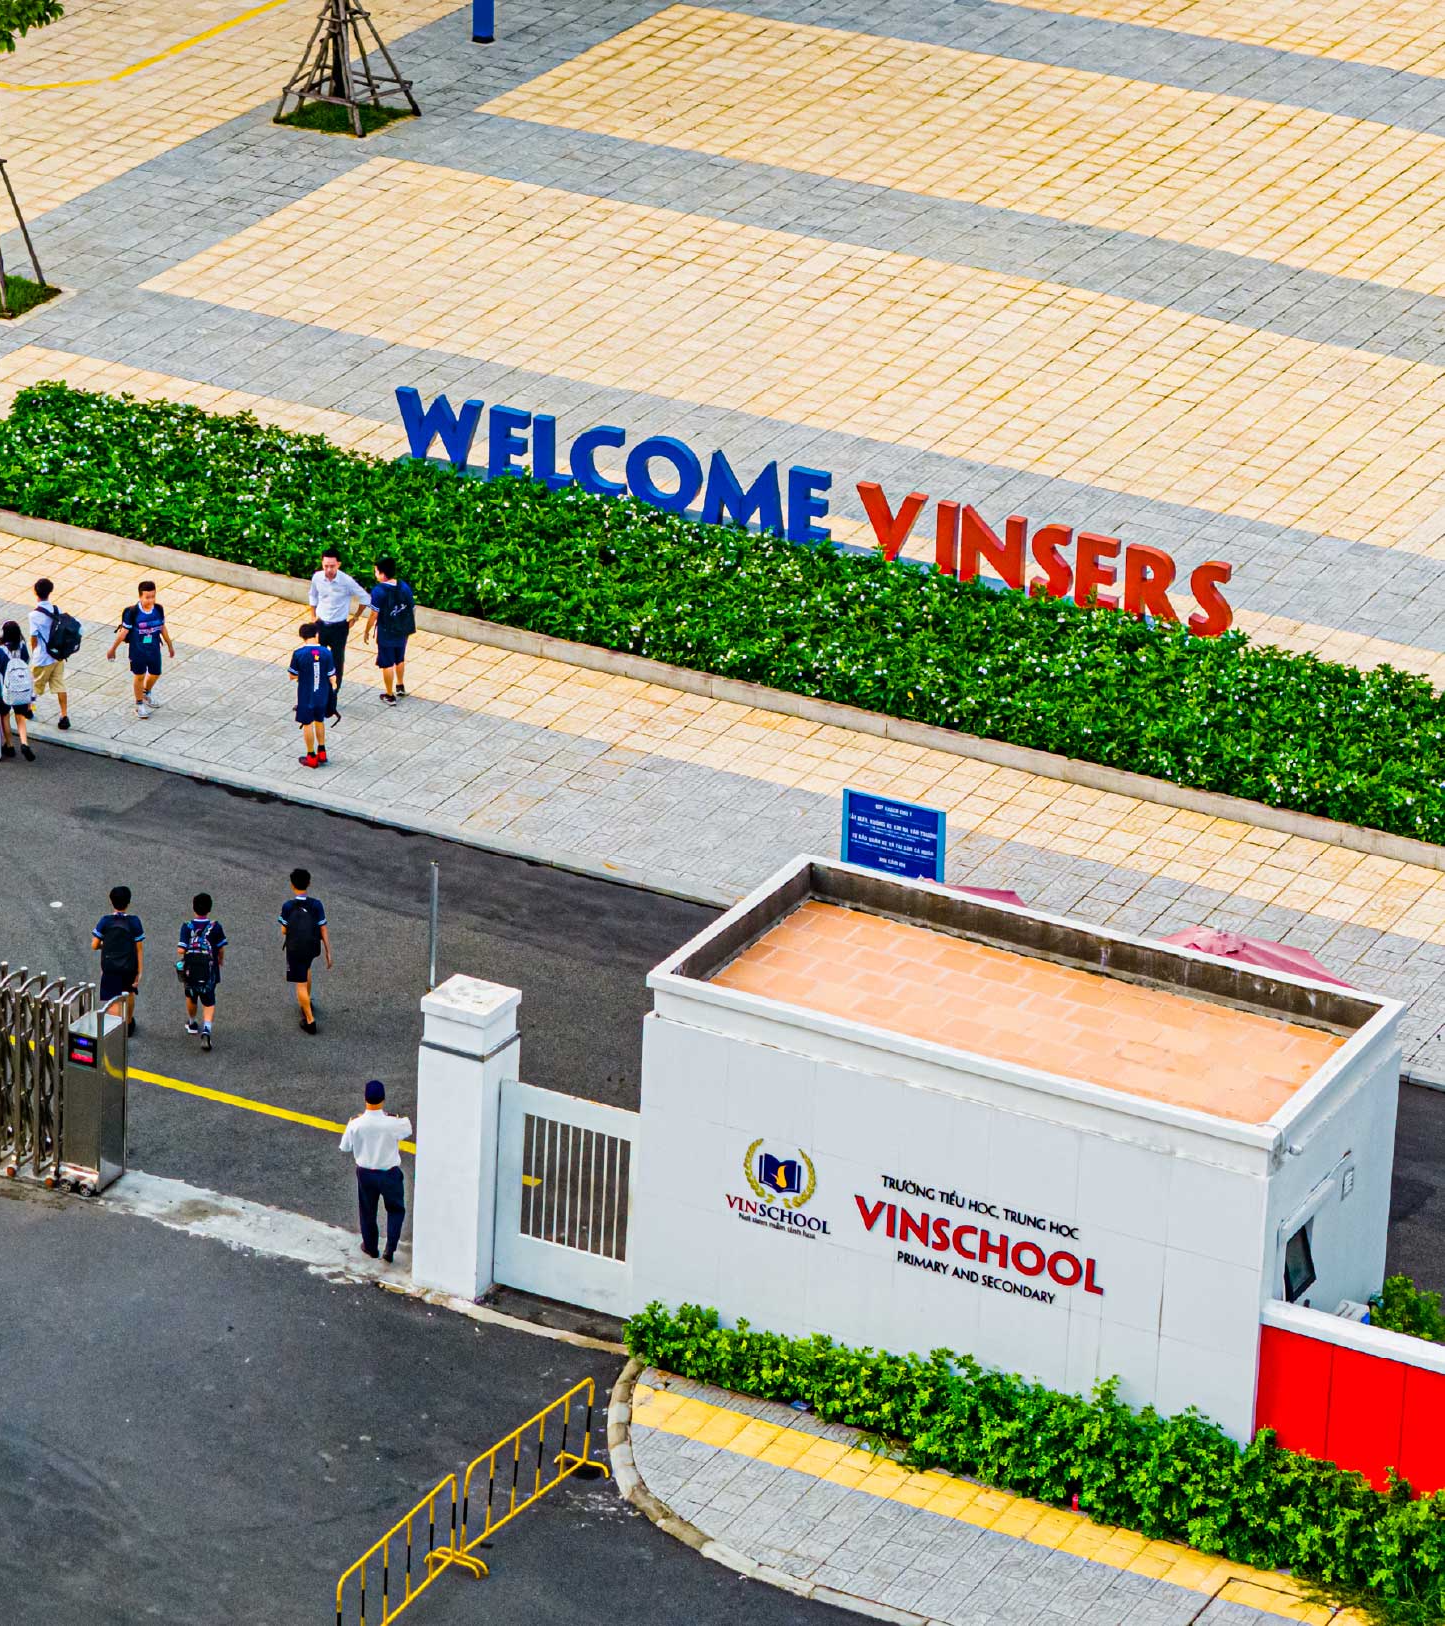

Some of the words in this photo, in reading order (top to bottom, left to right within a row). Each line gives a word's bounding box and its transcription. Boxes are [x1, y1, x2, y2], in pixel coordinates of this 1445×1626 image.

[395, 386, 832, 545] WELCOME
[856, 481, 1233, 637] VINSERS
[726, 1193, 831, 1235] VINSCHOOL
[1003, 1208, 1046, 1231] TRUNG
[854, 1194, 1104, 1296] VINSCHOOL
[897, 1250, 949, 1275] PRIMARY
[951, 1267, 979, 1283] AND
[981, 1275, 1056, 1304] SECONDARY
